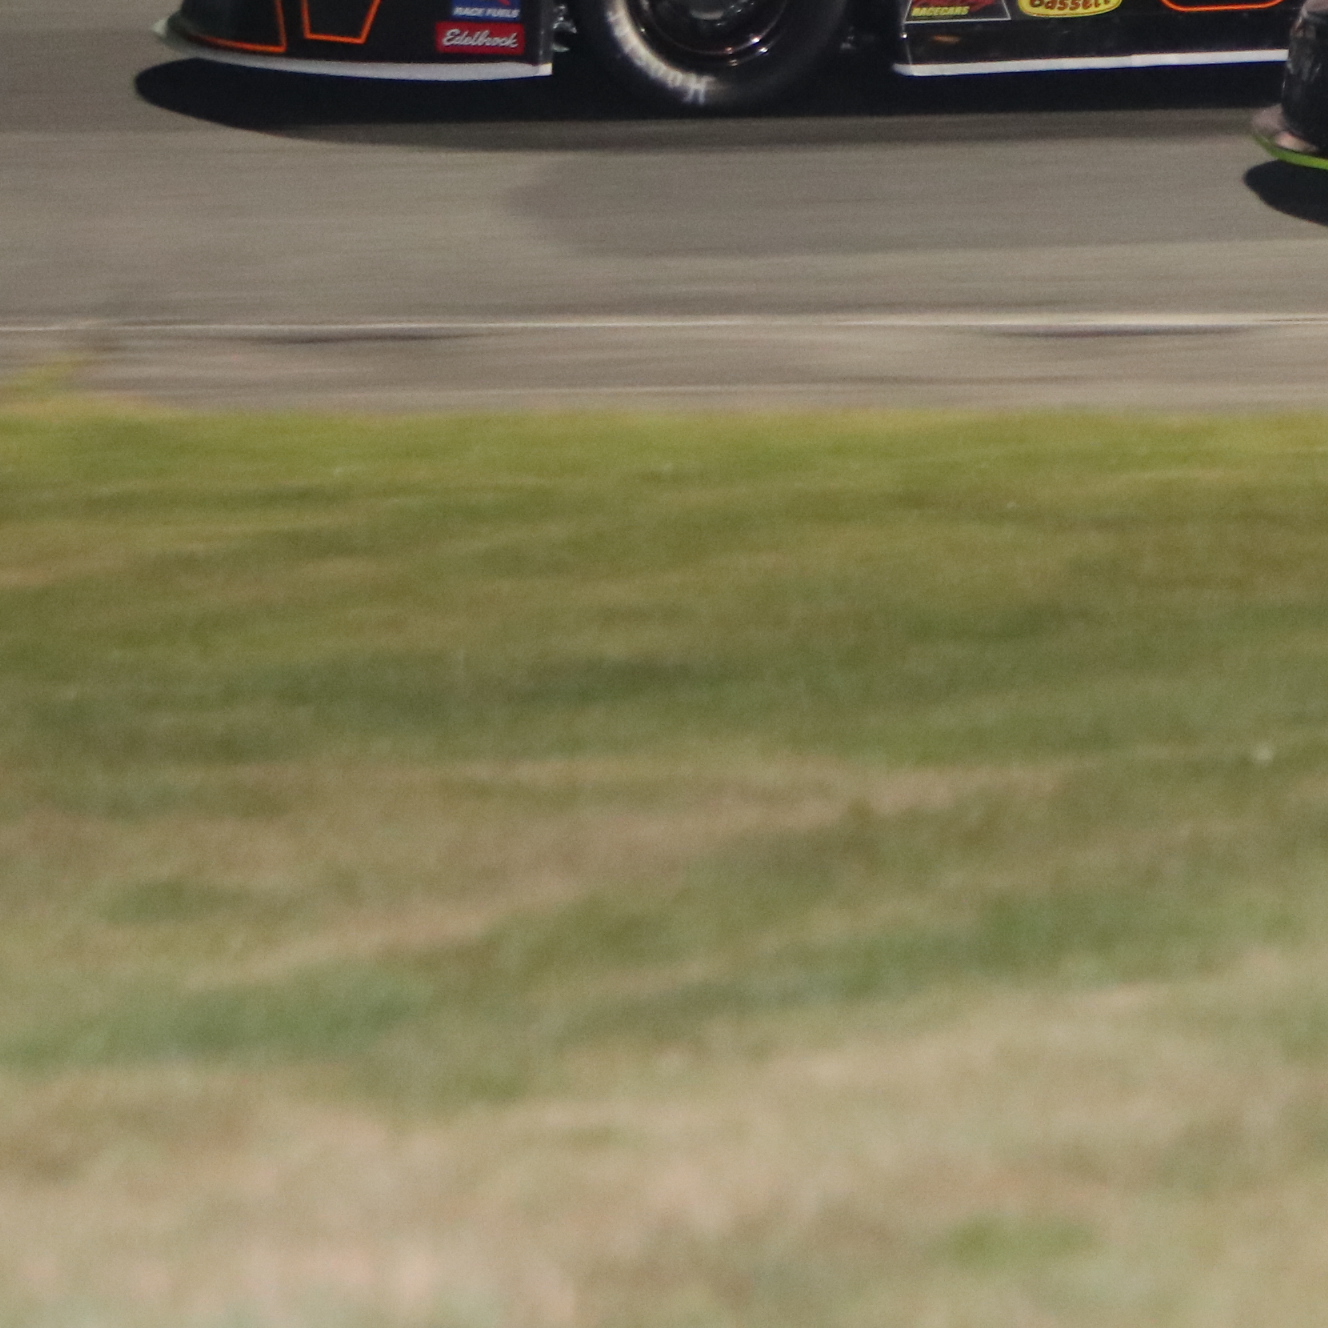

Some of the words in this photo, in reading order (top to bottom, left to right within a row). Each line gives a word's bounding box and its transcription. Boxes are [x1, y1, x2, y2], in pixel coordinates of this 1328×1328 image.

[453, 7, 484, 17] RACE
[487, 7, 520, 18] FUELS
[442, 28, 519, 48] Edelbrock
